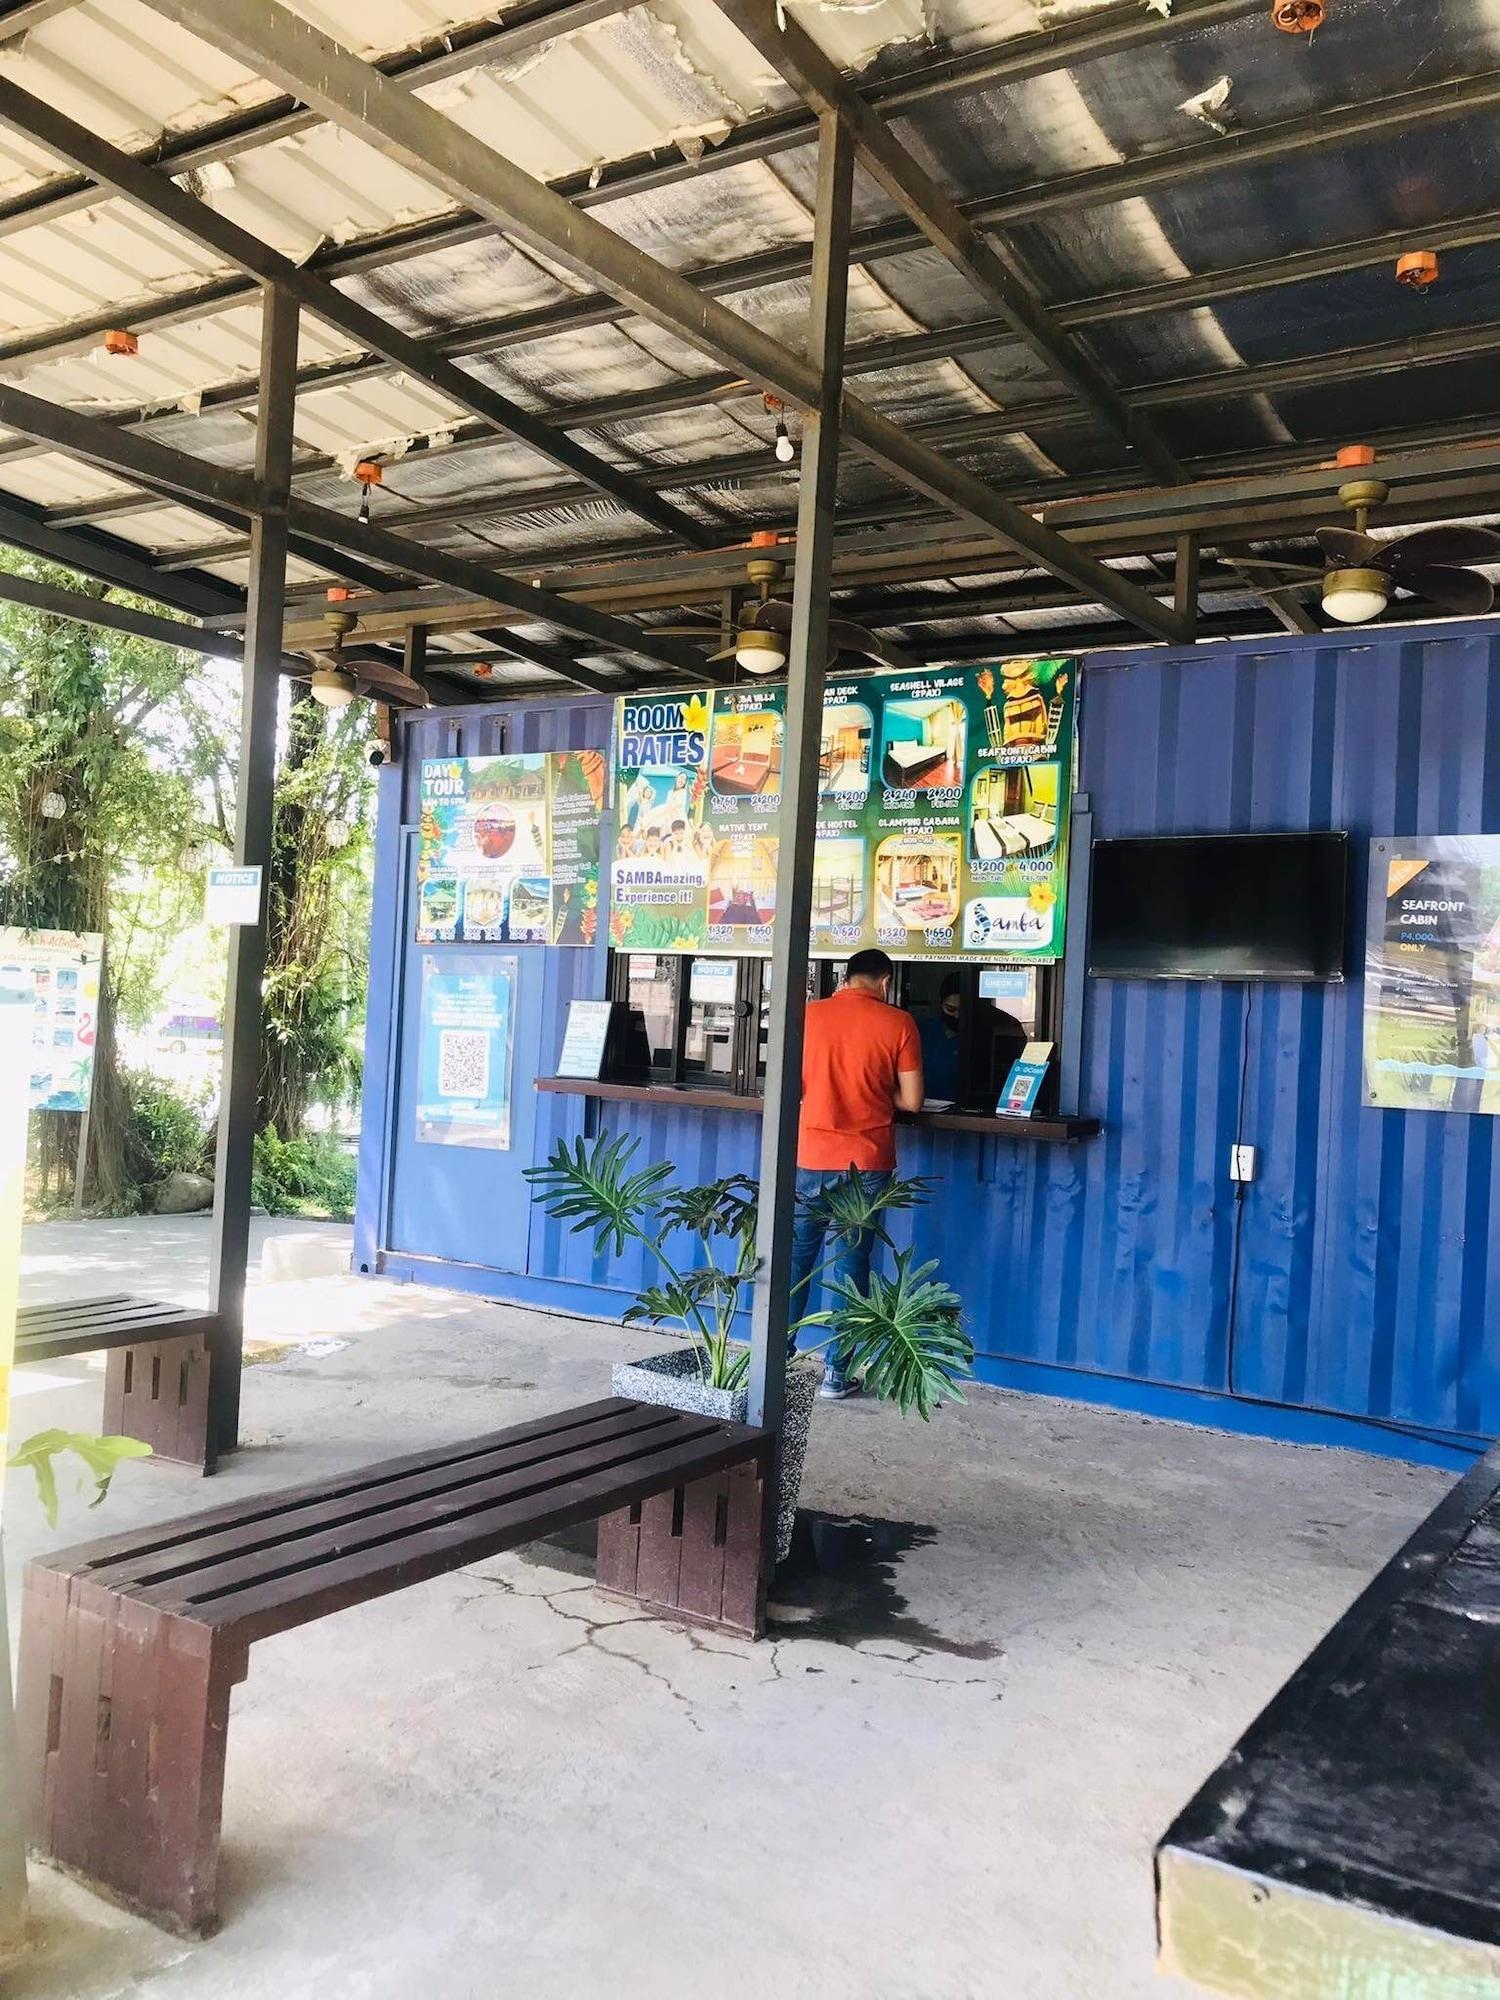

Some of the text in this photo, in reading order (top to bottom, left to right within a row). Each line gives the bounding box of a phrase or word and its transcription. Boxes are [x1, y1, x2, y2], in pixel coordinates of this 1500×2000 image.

[837, 686, 859, 696] DECK
[890, 681, 931, 693] SEASHELL
[624, 703, 686, 732] ROOM
[622, 733, 705, 767] RATES
[978, 744, 1058, 757] SEAFRONT CABIN
[424, 764, 451, 780] DAY
[424, 780, 465, 796] TOUR
[719, 822, 768, 833] NATIVE TENT
[828, 820, 858, 830] HOSTEL
[878, 817, 960, 828] GLAMPING CABANA
[215, 873, 255, 884] NOTICE
[616, 888, 692, 905] Experience it!
[1401, 900, 1465, 911] SEAFRONT
[1400, 914, 1438, 925] CABIN
[1400, 943, 1426, 952] ONLY
[924, 955, 957, 963] PAYMENTS
[959, 955, 977, 963] MADE
[696, 965, 728, 976] NOTICE
